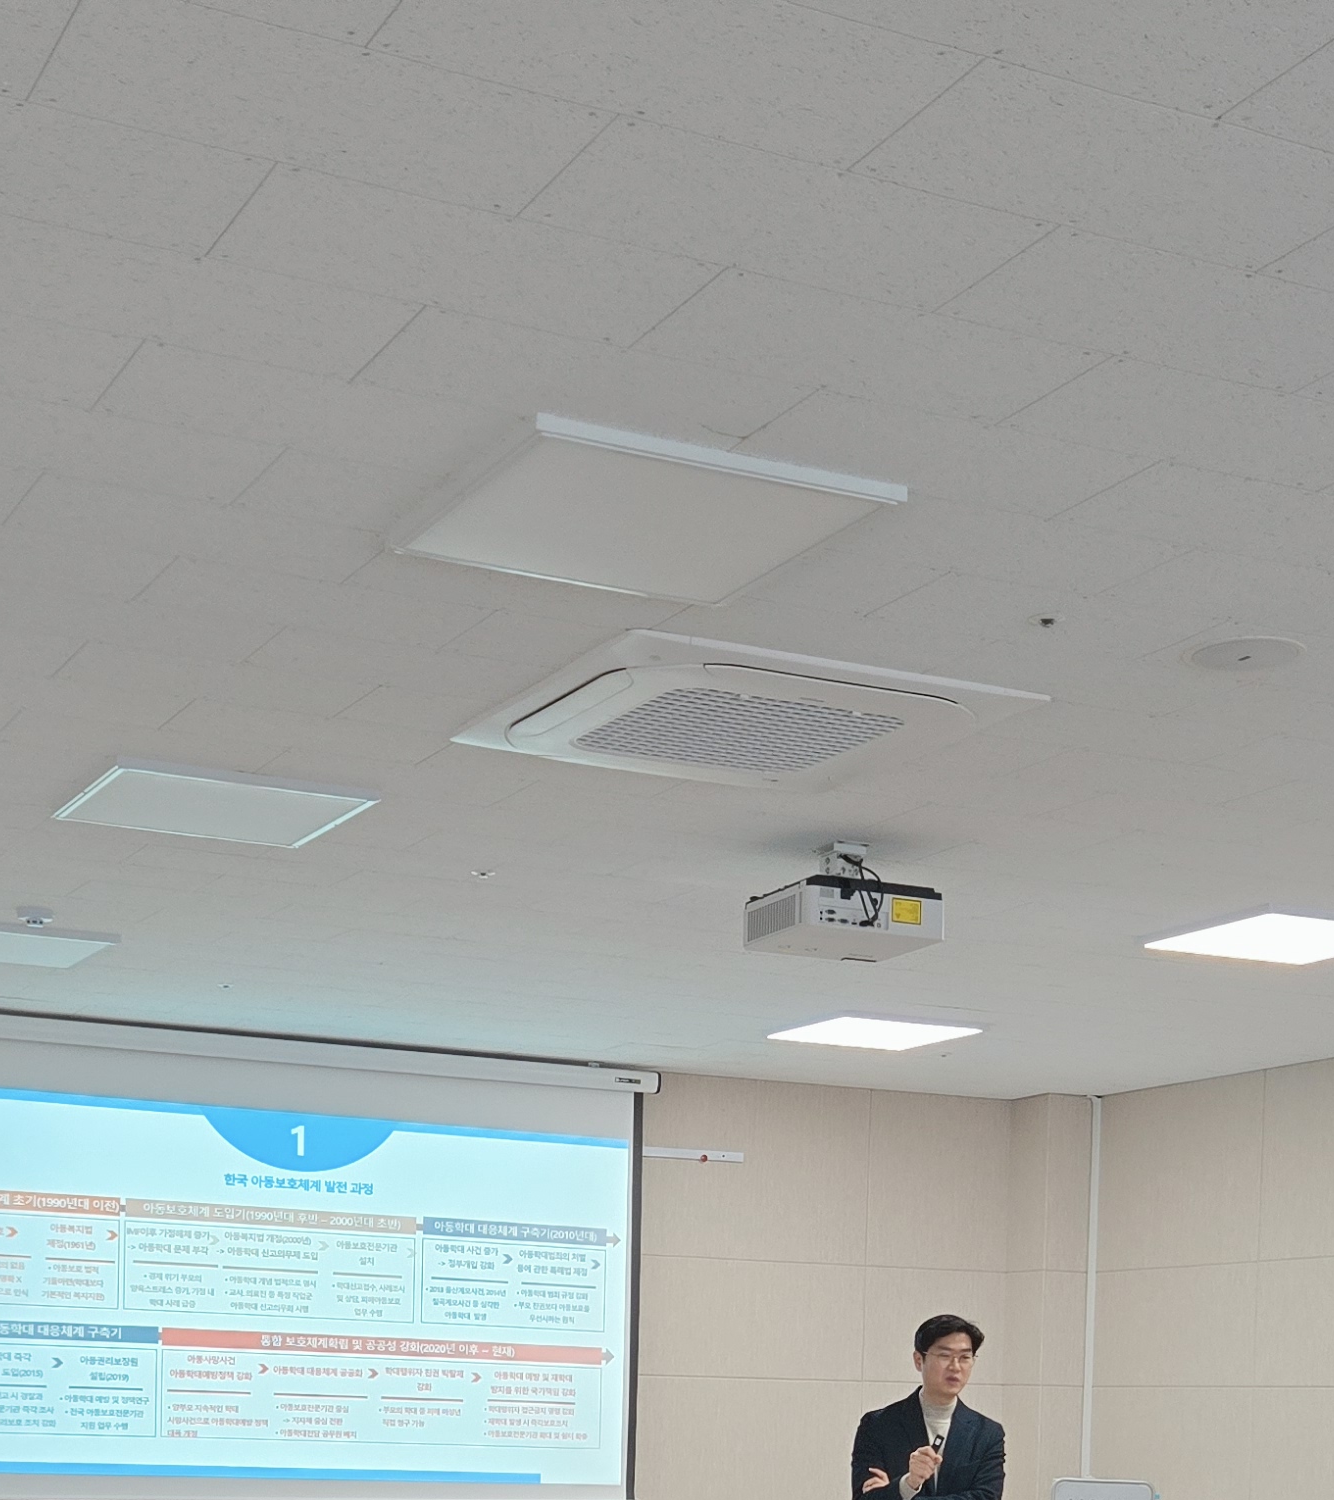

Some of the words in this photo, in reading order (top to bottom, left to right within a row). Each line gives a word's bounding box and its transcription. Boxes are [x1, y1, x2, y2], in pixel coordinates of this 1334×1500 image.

[291, 1125, 305, 1157] 1
[223, 1173, 248, 1187] 한국
[251, 1175, 321, 1192] 아동보호체계
[324, 1180, 348, 1194] 발전
[349, 1182, 374, 1196] 과정
[12, 1194, 89, 1210] 초기(1990년대
[93, 1200, 120, 1213] 이전)
[143, 1202, 210, 1217] 아동보호체계
[213, 1207, 294, 1223] 도입기(1990년대
[298, 1213, 318, 1225] 후반
[329, 1216, 374, 1228] 2000년대
[377, 1218, 401, 1231] 초반)
[50, 1223, 93, 1235] 아동복지법
[434, 1221, 475, 1234] 아동학대
[478, 1223, 518, 1237] 대응체계
[520, 1226, 597, 1243] 구축기(2010년대)
[193, 1230, 210, 1241] 증가
[224, 1231, 265, 1243] 아동복지법
[138, 1243, 172, 1254] 아동학대
[174, 1244, 191, 1254] 문제
[192, 1246, 209, 1256] 부각
[336, 1240, 398, 1253] 아동보호전문기관
[435, 1244, 465, 1254] 아동학대
[467, 1245, 482, 1255] 사건
[484, 1247, 499, 1256] 증가
[227, 1246, 259, 1257] 아동학대
[261, 1249, 301, 1260] 신고의무제
[302, 1251, 319, 1261] 도입
[519, 1250, 570, 1262] 아동학대범죄의
[571, 1252, 587, 1262] 처벌
[359, 1256, 375, 1266] 설치
[448, 1259, 478, 1270] 정부개입
[480, 1261, 495, 1270] 강화
[533, 1265, 548, 1274] 관한
[229, 1275, 257, 1285] 아동학대
[230, 1302, 259, 1311] 아동학대
[444, 1311, 471, 1320] 아동학대
[37, 1324, 85, 1338] 대응체계
[87, 1326, 122, 1340] 구축기
[260, 1334, 282, 1348] 통합
[285, 1336, 349, 1350] 보호체계확립
[352, 1340, 363, 1351] 및
[365, 1340, 397, 1352] 공공성
[399, 1341, 456, 1355] 강화(2020년
[459, 1343, 479, 1356] 이후
[492, 1346, 516, 1358] 현재)
[80, 1356, 139, 1367] 아동권리보장원
[187, 1354, 236, 1366] 아동사망사건
[1, 1368, 44, 1379] 도입(2015)
[89, 1371, 130, 1382] 설립(2019)
[169, 1369, 235, 1381] 아동학대예방정책
[237, 1371, 253, 1381] 강화
[273, 1366, 305, 1376] 아동학대
[307, 1367, 338, 1377] 대응체계
[494, 1371, 524, 1381] 아동학대
[417, 1382, 432, 1392] 강화
[87, 1408, 145, 1418] 아동보호전문기관
[280, 1403, 334, 1413] 아동보호전문기관
